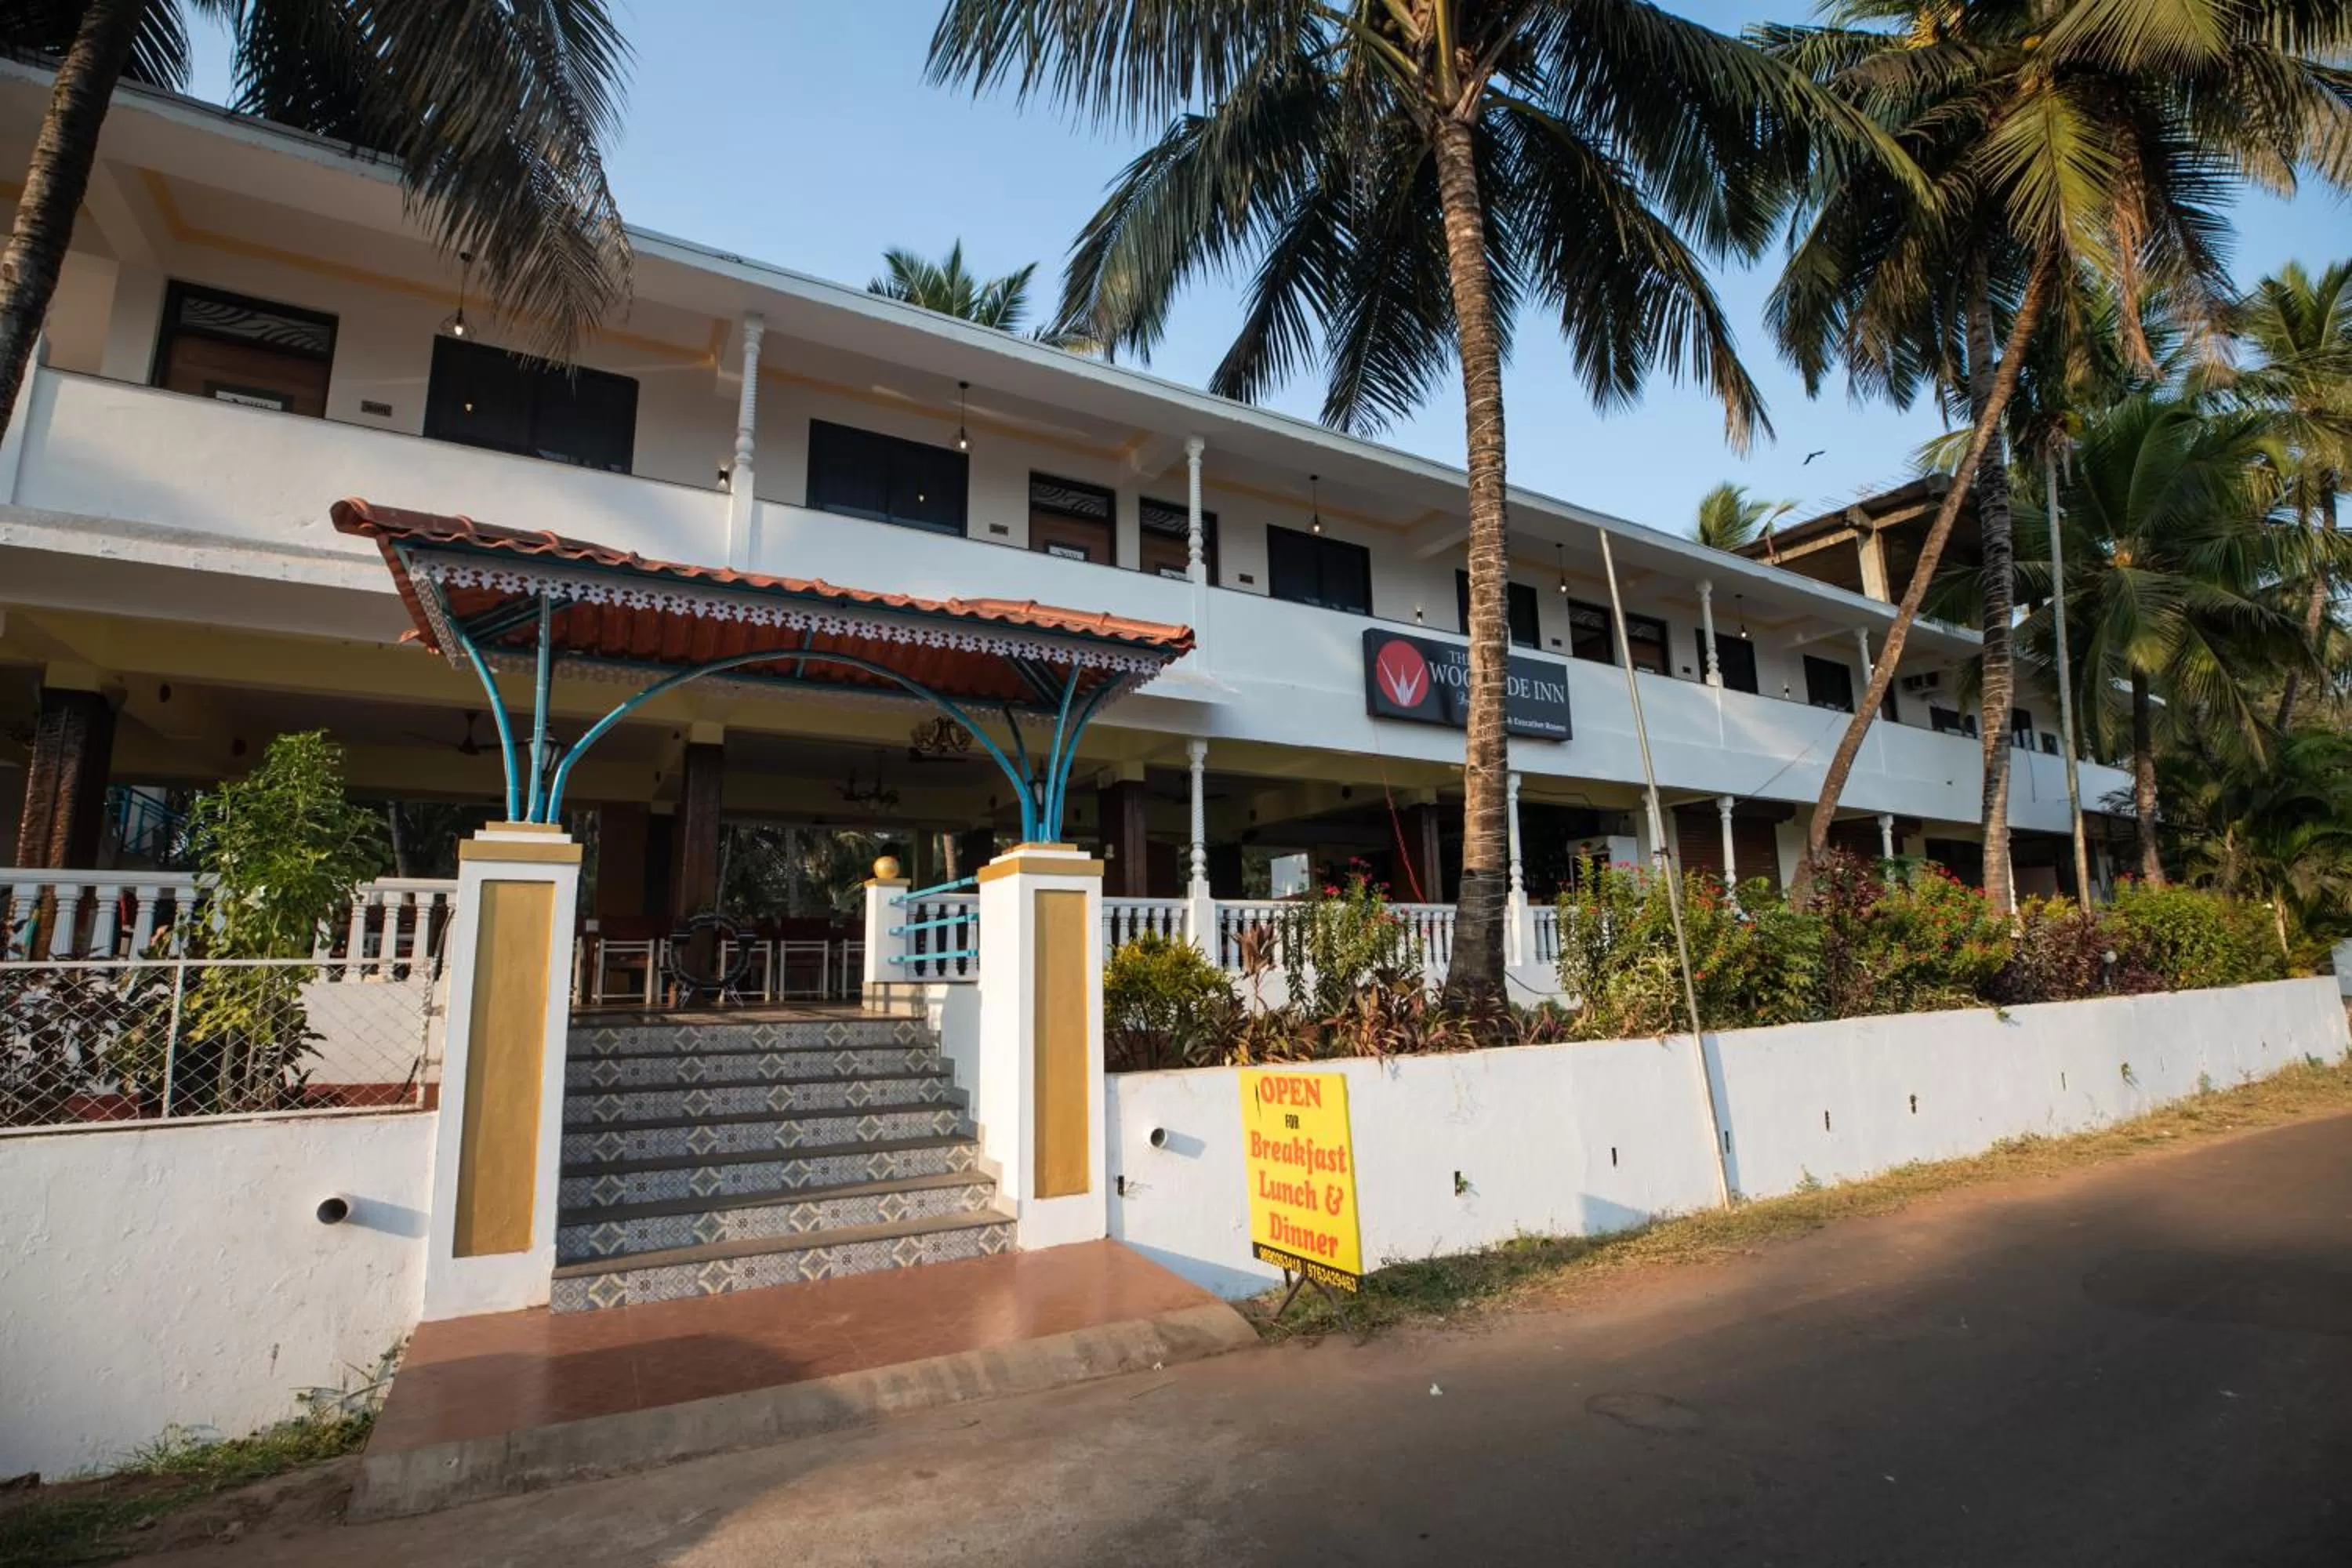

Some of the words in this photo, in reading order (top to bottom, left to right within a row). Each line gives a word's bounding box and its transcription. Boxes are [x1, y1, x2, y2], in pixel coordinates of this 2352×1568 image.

[1534, 680, 1565, 703] INN
[1260, 1076, 1321, 1108] OPEN
[1285, 1113, 1299, 1130] FOR
[1250, 1129, 1348, 1174] Breakfast
[1258, 1170, 1318, 1211] Lunch
[1325, 1183, 1344, 1217] &
[1269, 1211, 1338, 1258] Dinner
